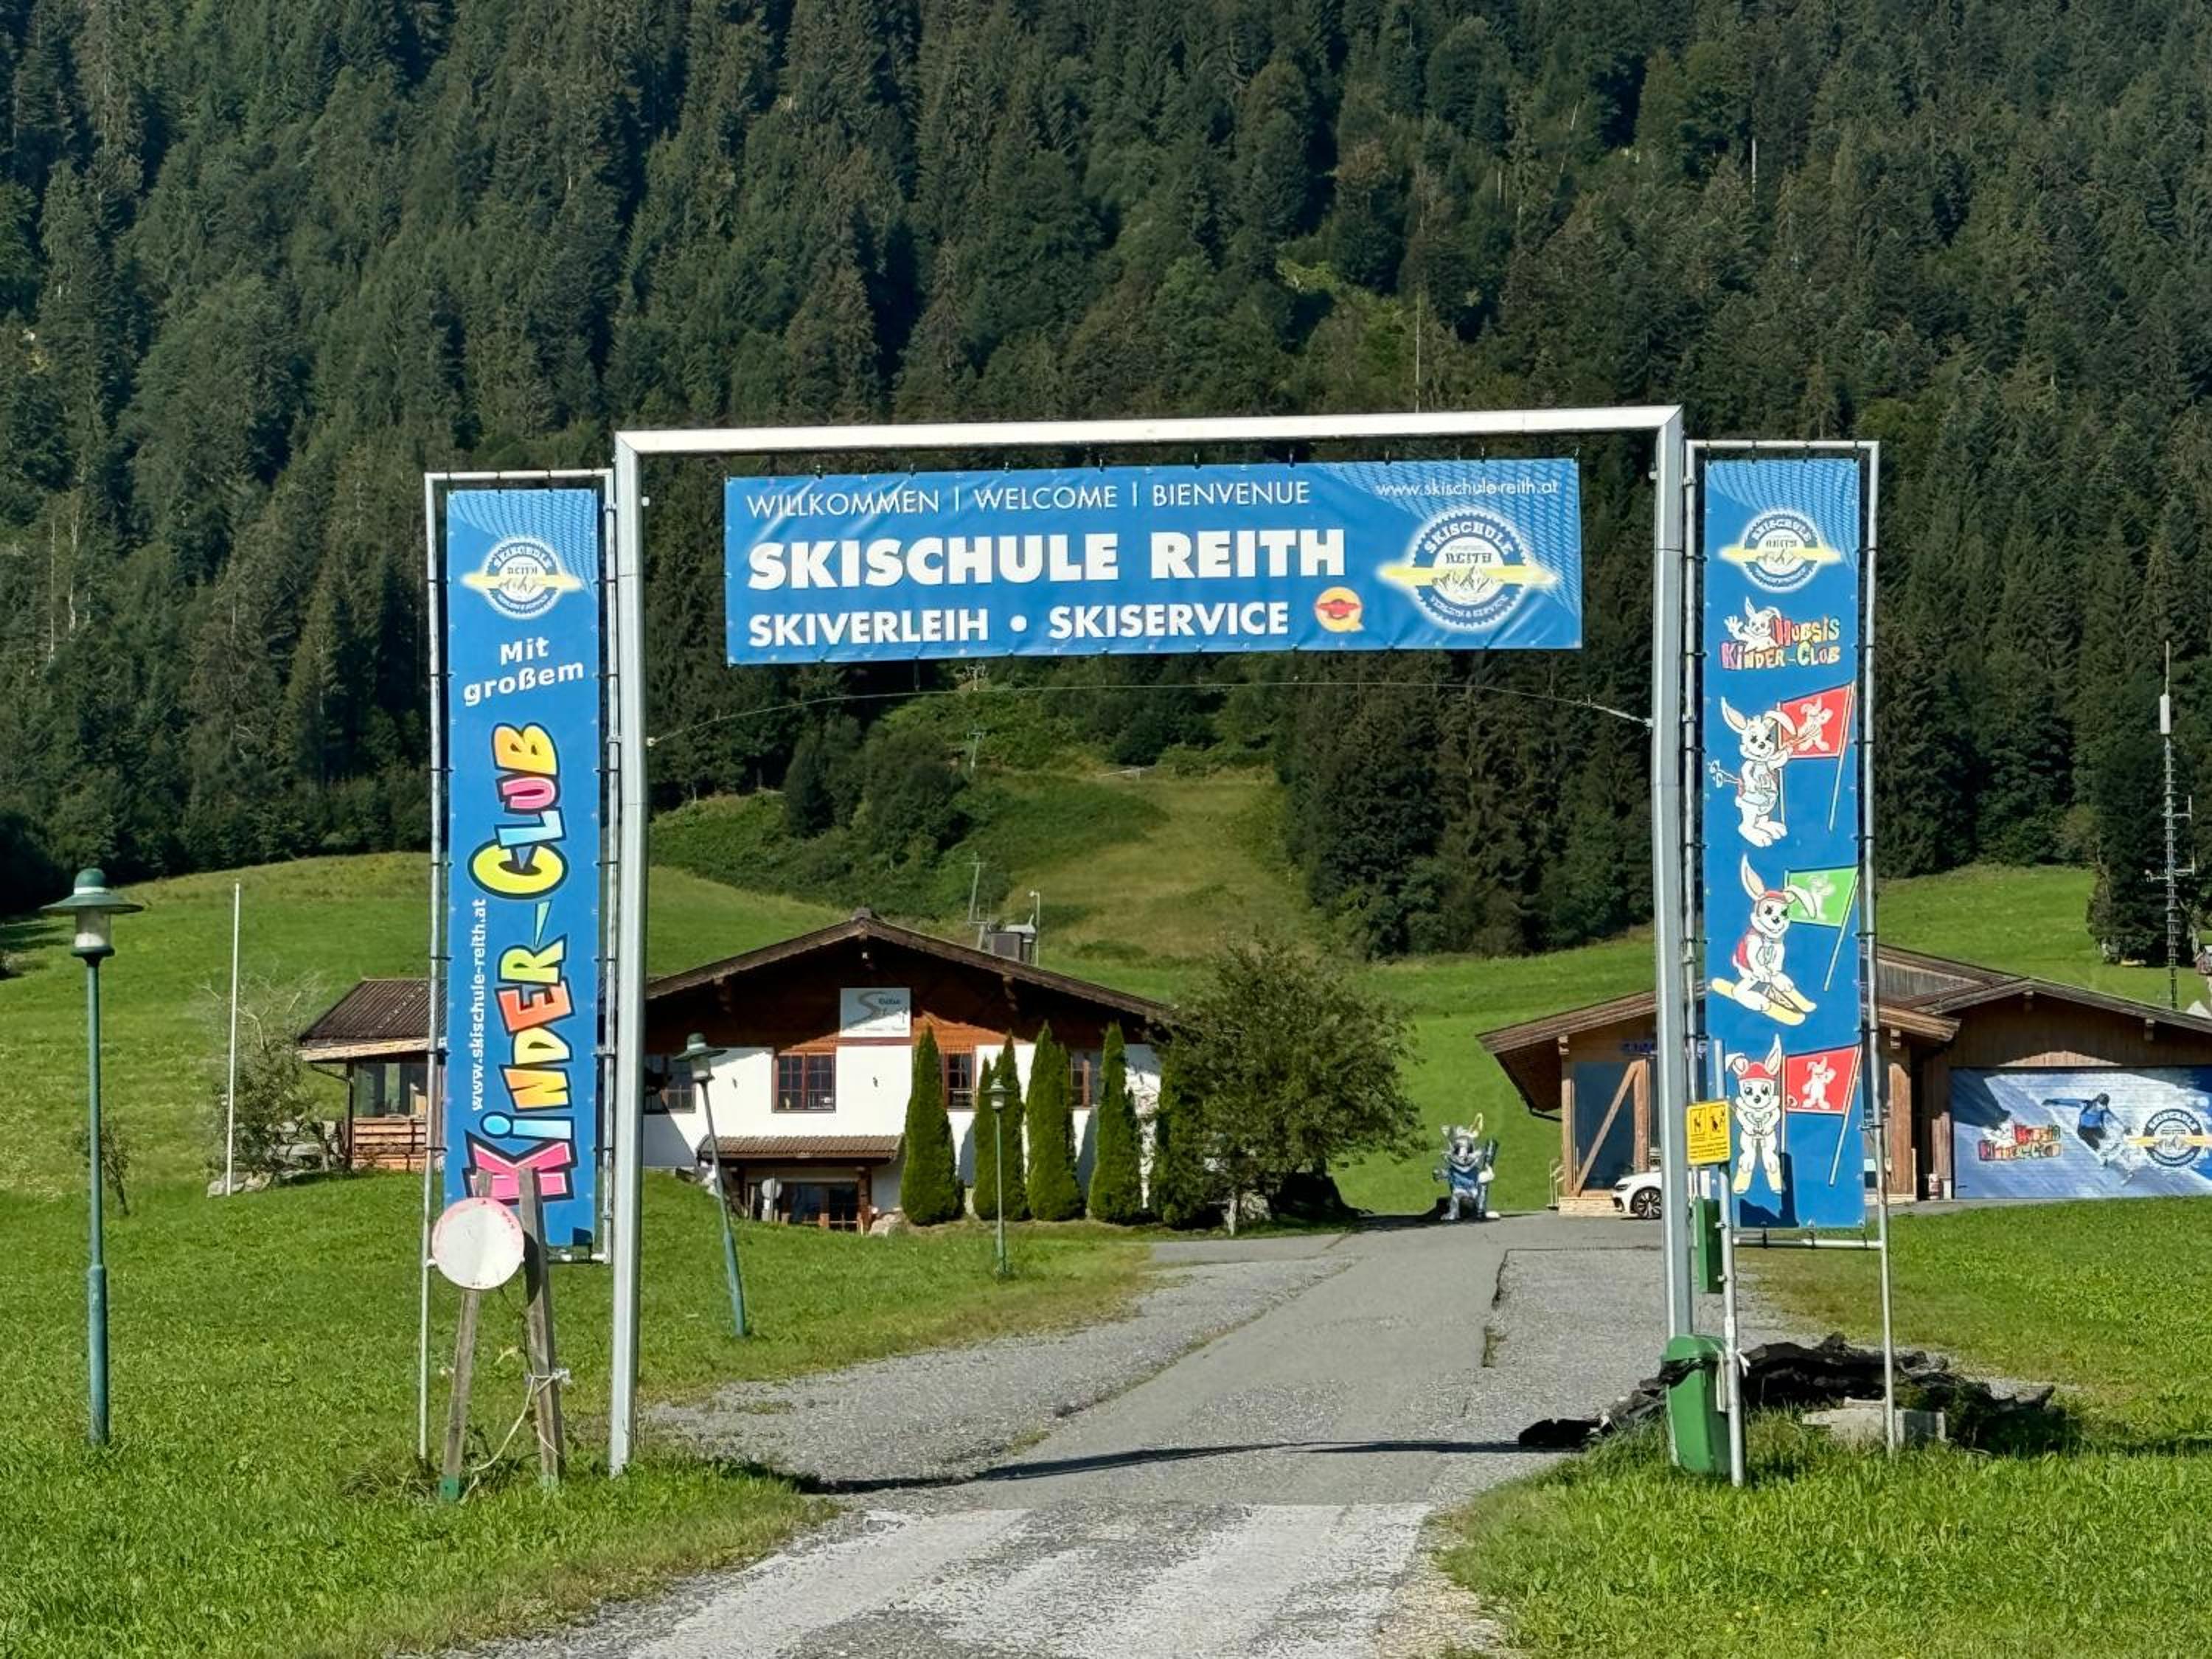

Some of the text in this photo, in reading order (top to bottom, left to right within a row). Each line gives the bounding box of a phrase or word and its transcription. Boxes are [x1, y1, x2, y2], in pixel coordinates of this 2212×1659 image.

[747, 481, 1310, 518] WILLKOMMEN WELCOME BIENVENUE
[748, 529, 1346, 591] SKISCHULE REITH
[1424, 521, 1514, 556] SKISCHULE
[749, 601, 1289, 647] SKIVERLEIH SKISERVICE
[501, 636, 549, 665] Mit
[464, 661, 584, 707] großem
[469, 899, 487, 1111] www.skischule-reith.at
